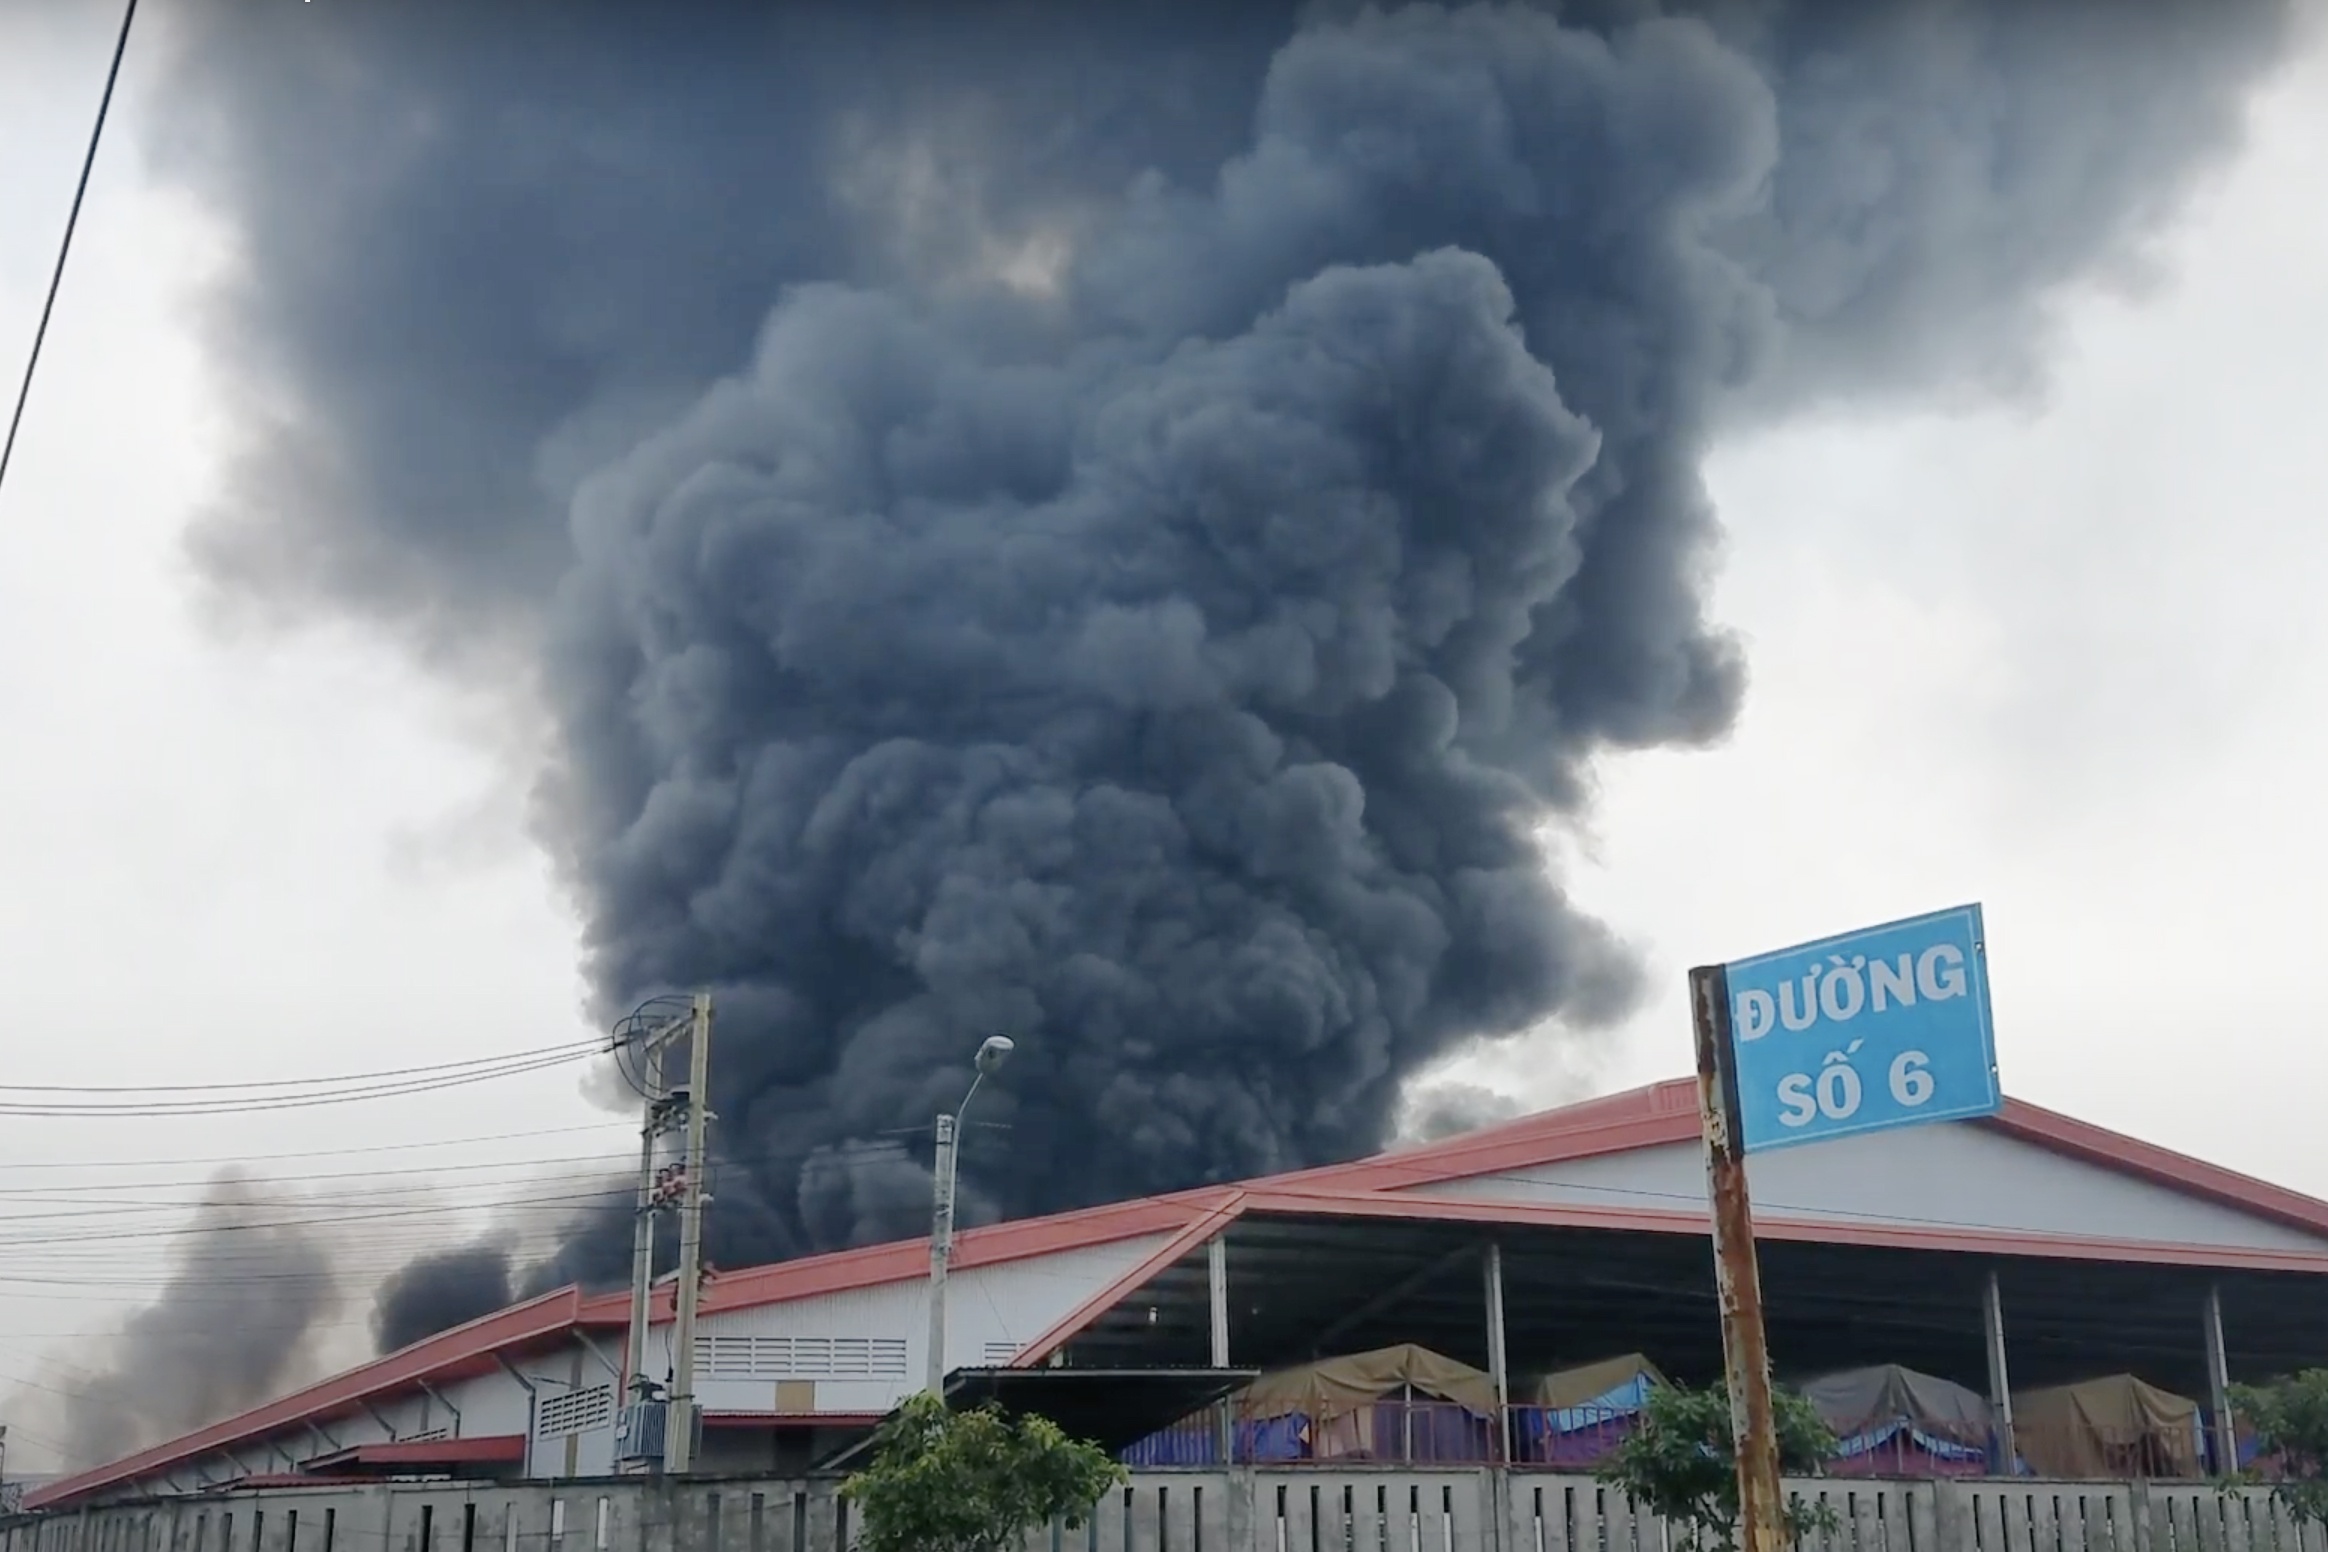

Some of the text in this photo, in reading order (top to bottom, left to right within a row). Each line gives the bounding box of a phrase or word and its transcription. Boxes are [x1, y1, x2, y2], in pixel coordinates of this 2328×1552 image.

[1735, 943, 1967, 1042] ĐƯỜNG
[1777, 1038, 1935, 1127] SỐ 6
